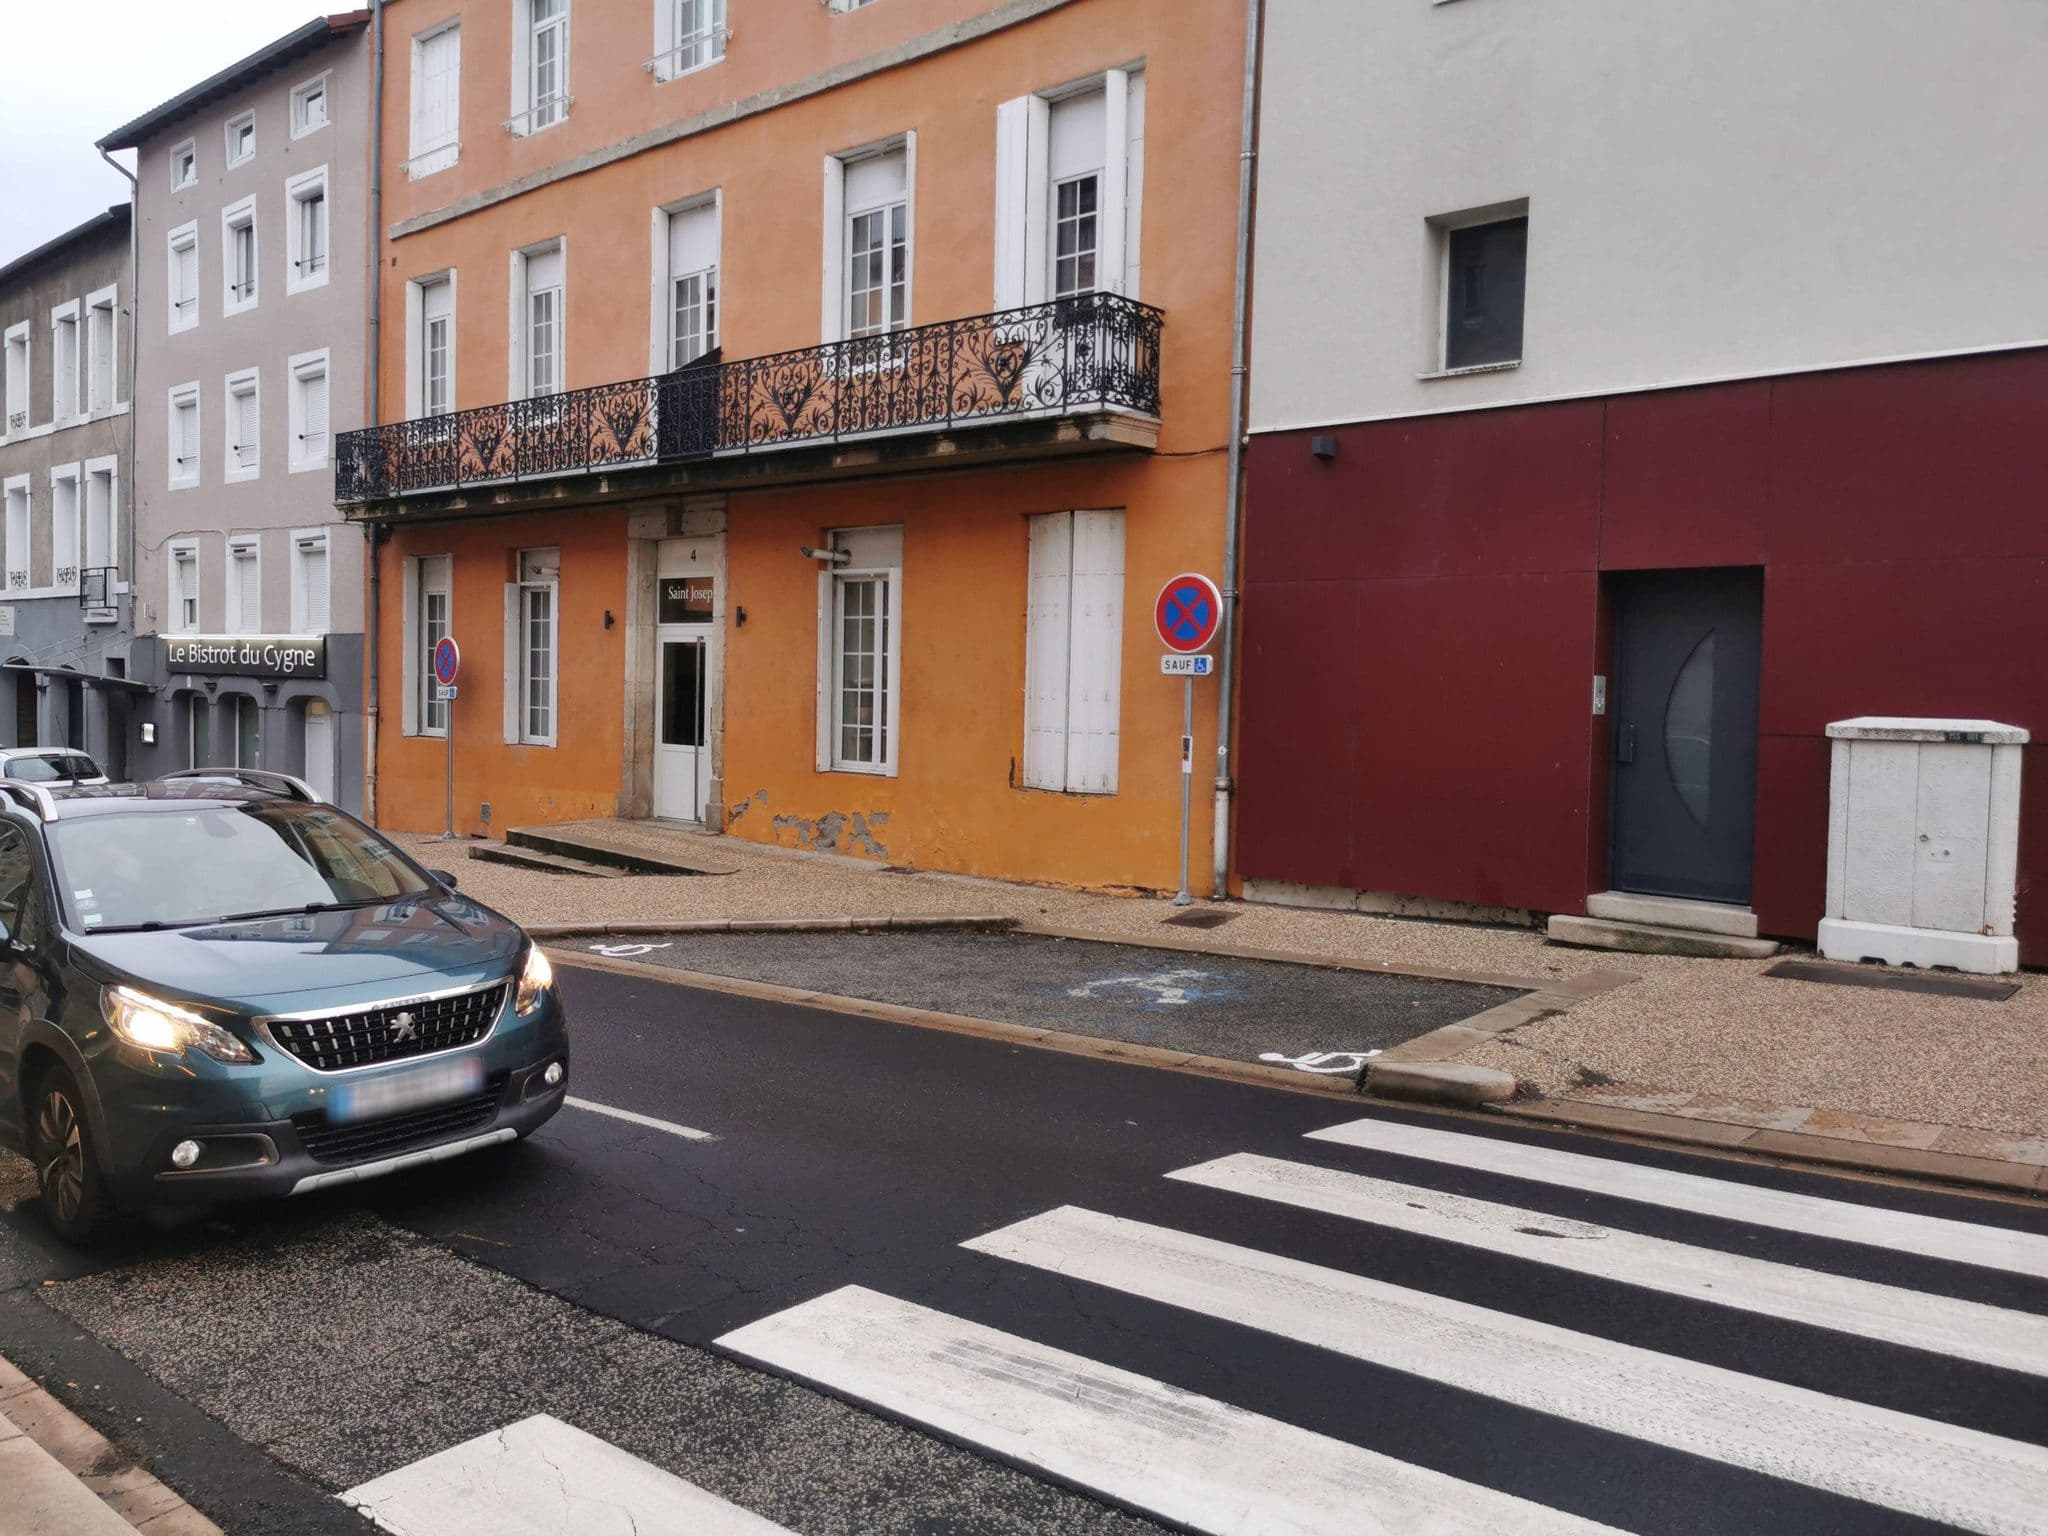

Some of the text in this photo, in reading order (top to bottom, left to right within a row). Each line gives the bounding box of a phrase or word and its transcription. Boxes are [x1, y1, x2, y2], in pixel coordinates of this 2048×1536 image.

[690, 549, 697, 562] 4
[668, 585, 713, 603] Saint Josep
[169, 643, 316, 673] Le Bistrot du Cygne
[1164, 659, 1192, 670] SAUF
